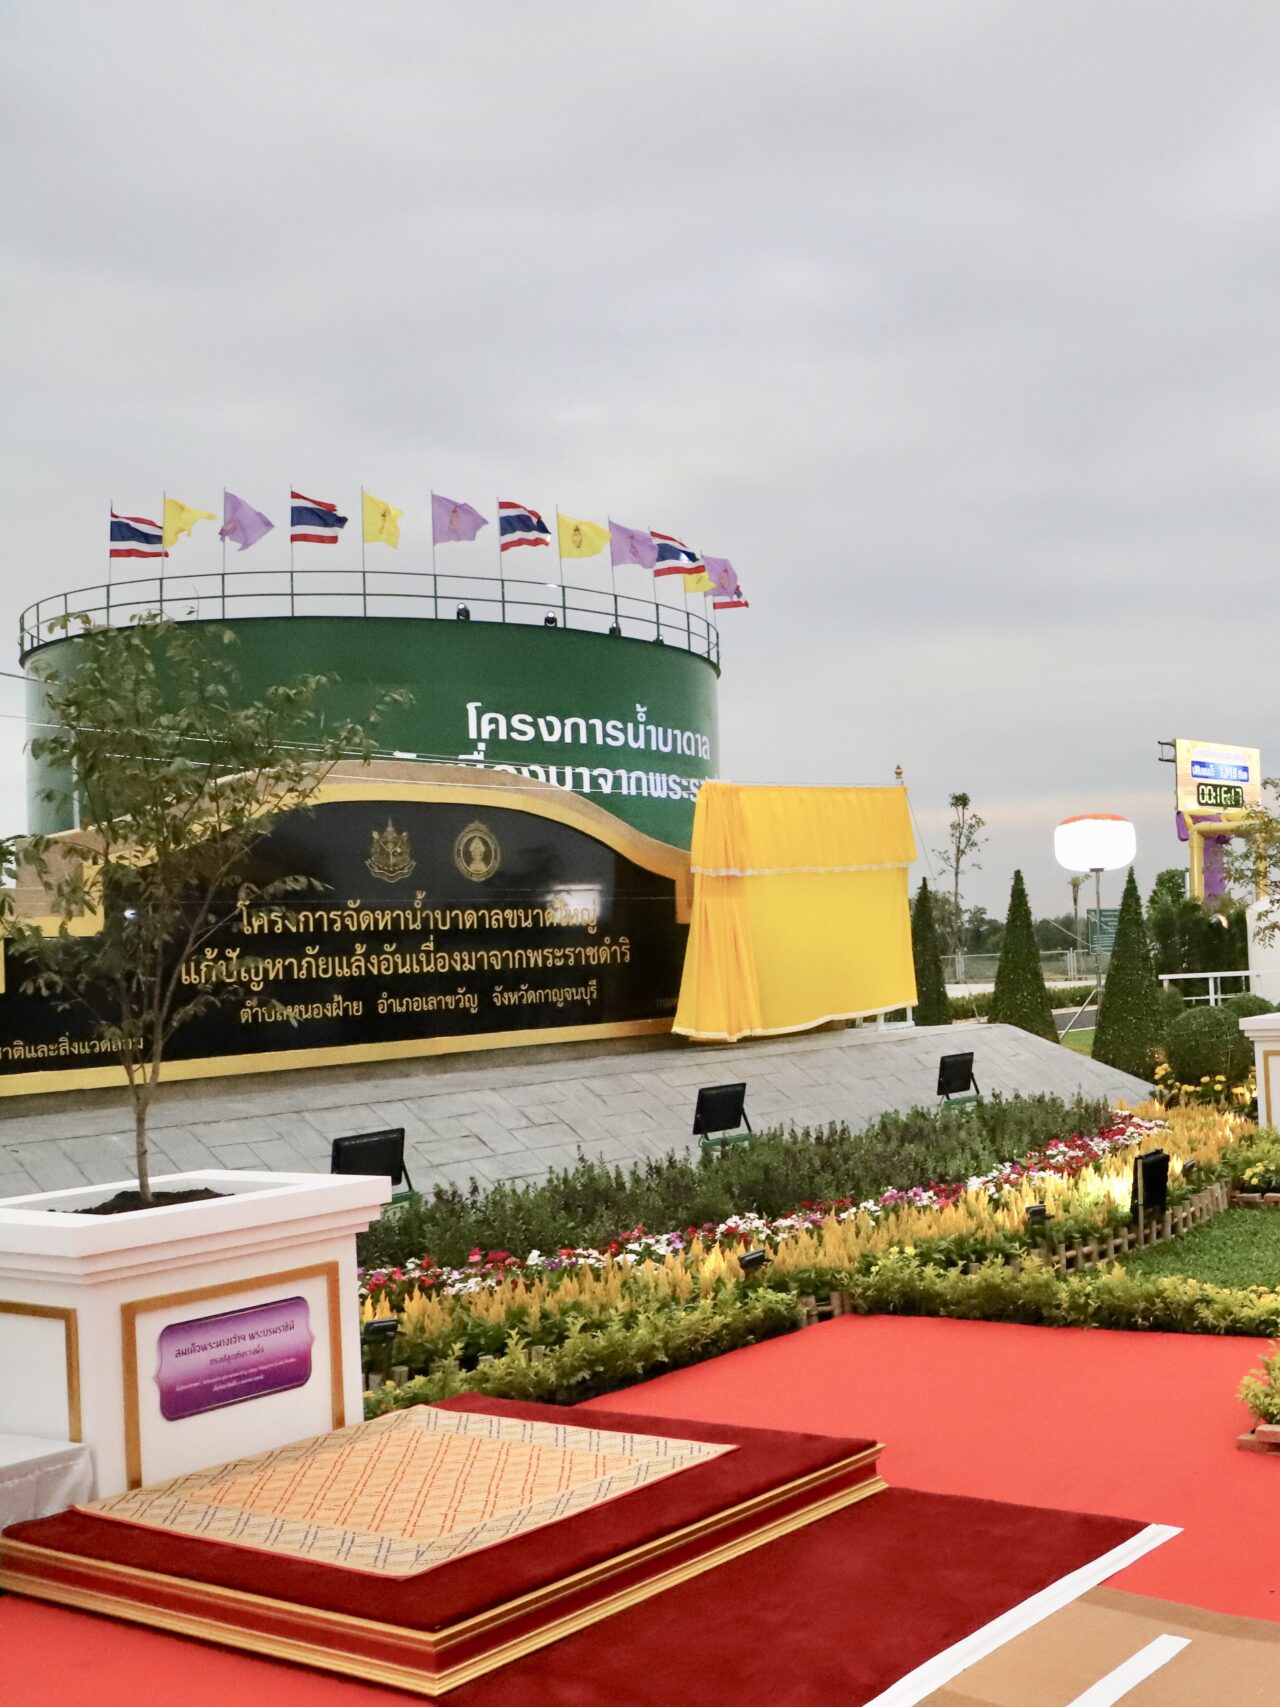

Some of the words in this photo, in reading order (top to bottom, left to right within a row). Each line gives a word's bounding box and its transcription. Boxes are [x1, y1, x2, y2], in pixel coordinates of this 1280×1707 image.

[466, 702, 711, 761] โครงการน้ำบาดาล
[181, 935, 631, 992] แก้ปัญหาภัยแล้งอันเนื่องมาจากพระราชดำริ
[240, 993, 363, 1024] ตำบลหนองฝ้าย
[377, 986, 478, 1014] อำเภอเลาขวัญ
[492, 979, 598, 1008] จังหวัดกาญจนบุรี
